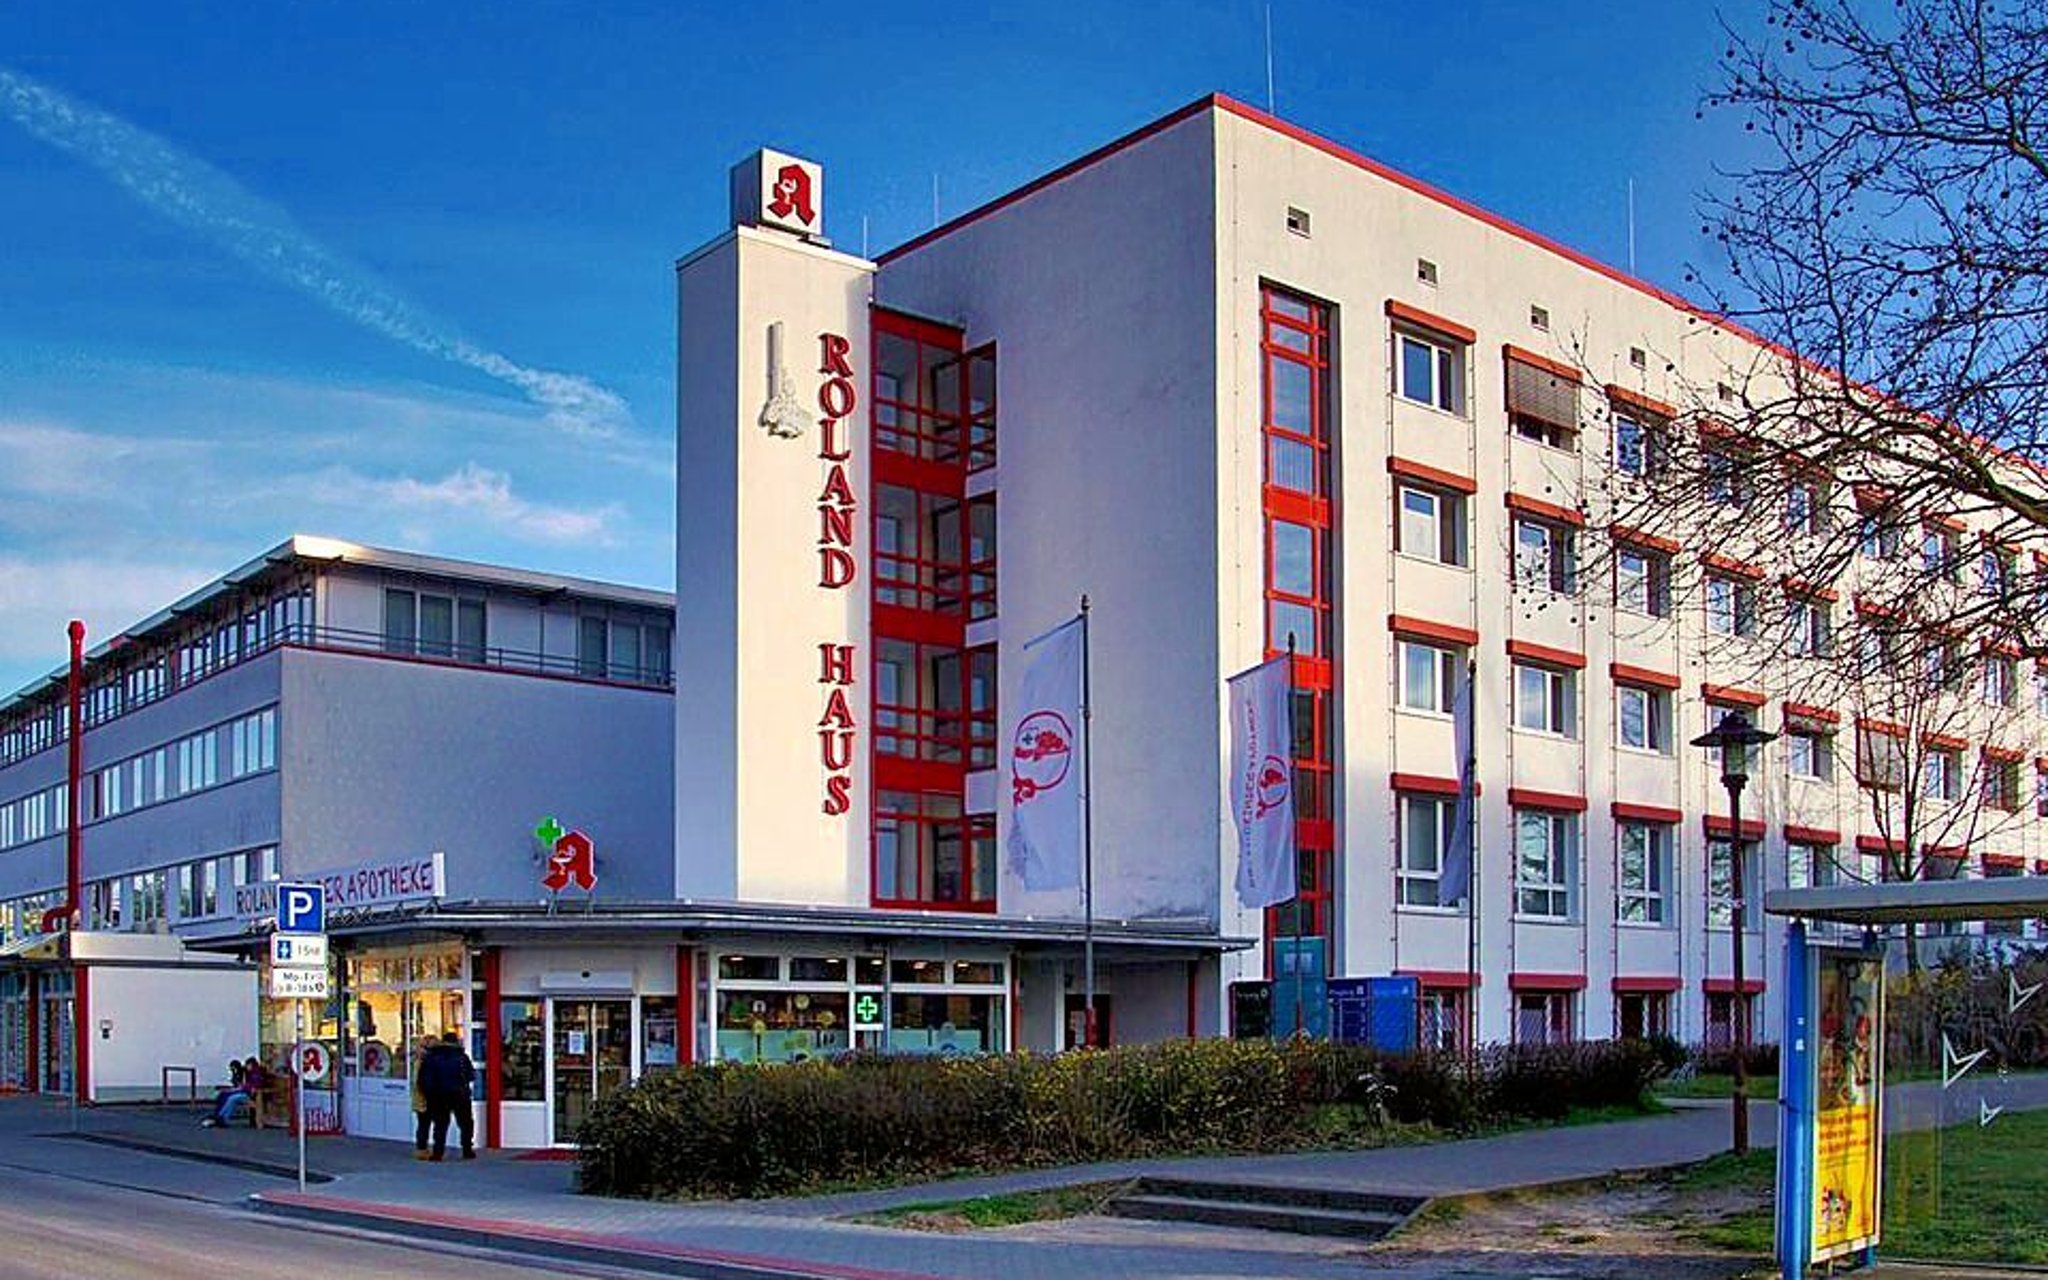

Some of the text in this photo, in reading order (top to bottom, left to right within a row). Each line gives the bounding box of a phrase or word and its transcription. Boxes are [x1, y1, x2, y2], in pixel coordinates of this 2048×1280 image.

[817, 332, 856, 816] ROLAND HAUS
[347, 861, 433, 902] APOTHEKE
[288, 891, 313, 927] P
